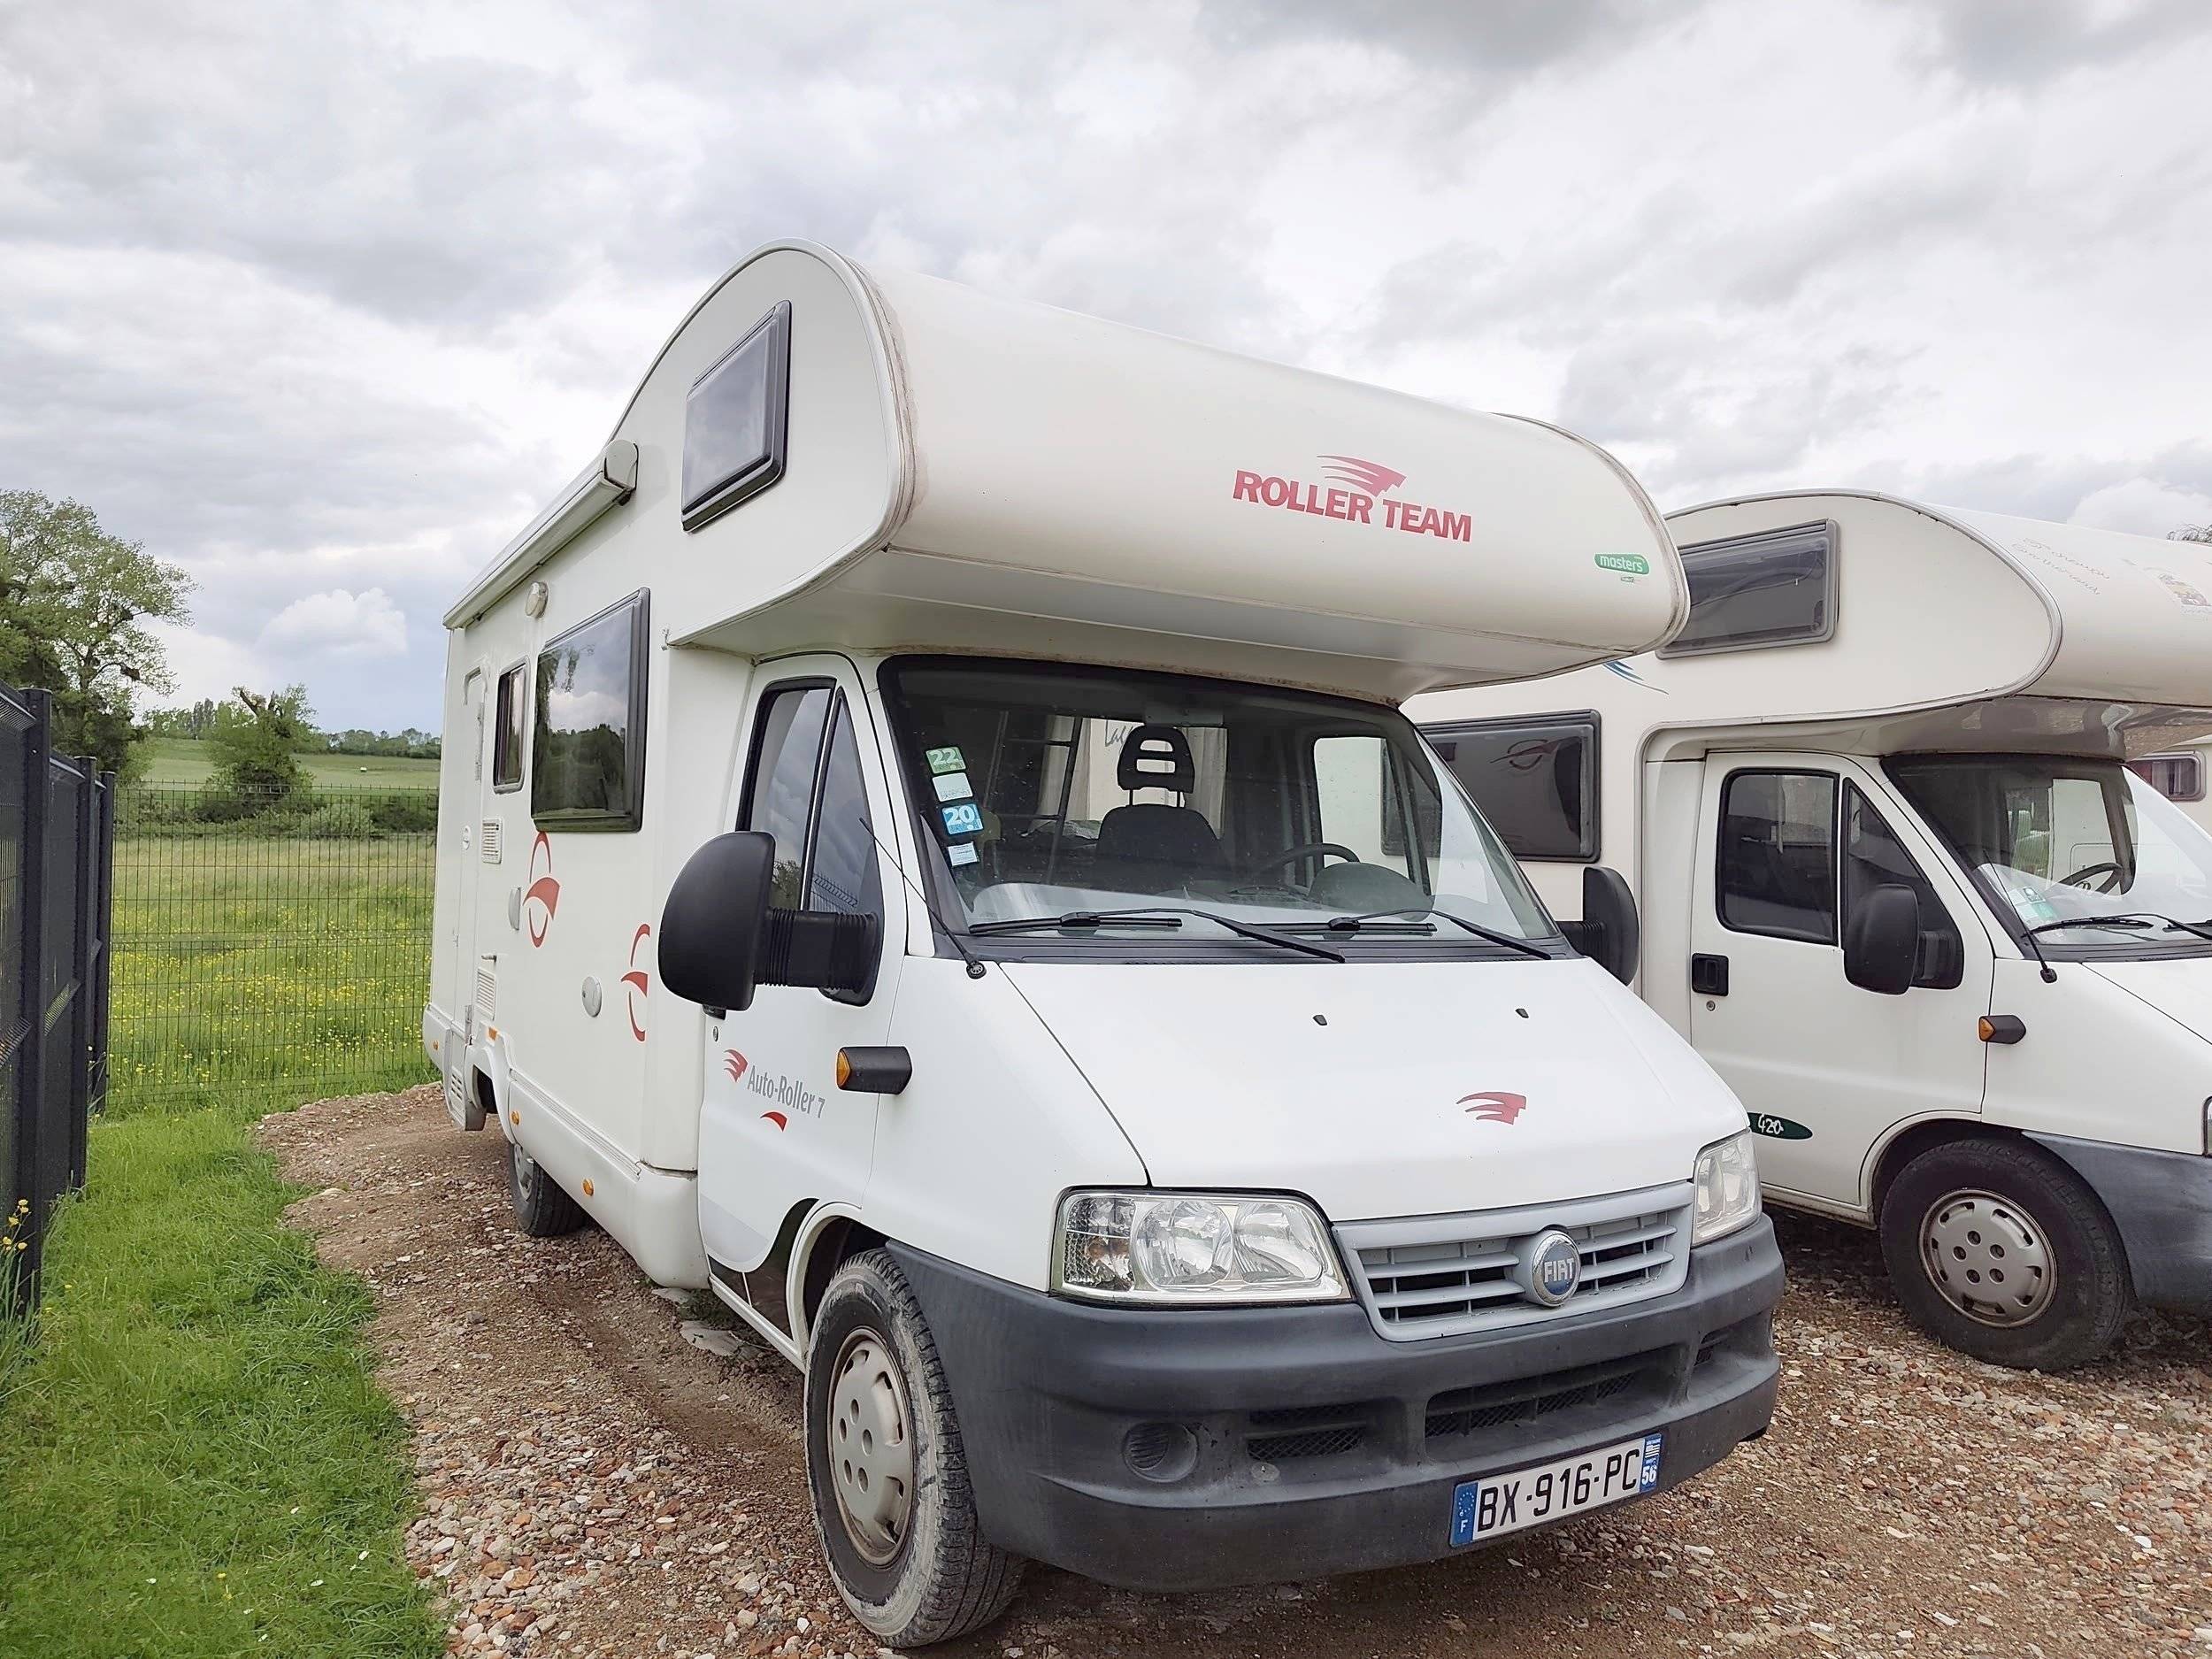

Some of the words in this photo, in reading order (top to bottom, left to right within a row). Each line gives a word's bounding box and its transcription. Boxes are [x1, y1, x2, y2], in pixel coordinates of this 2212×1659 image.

[1233, 469, 1374, 524] ROLLER
[1382, 498, 1472, 542] TEAM
[1600, 555, 1643, 572] masters
[928, 748, 957, 766] 22
[943, 804, 976, 826] 20
[747, 1064, 816, 1115] Auto-Roller
[817, 1097, 826, 1119] 7
[1543, 1257, 1575, 1283] FIAT
[1641, 1464, 1657, 1486] 56
[1477, 1448, 1640, 1532] BX-916-PC
[1460, 1518, 1469, 1533] F
